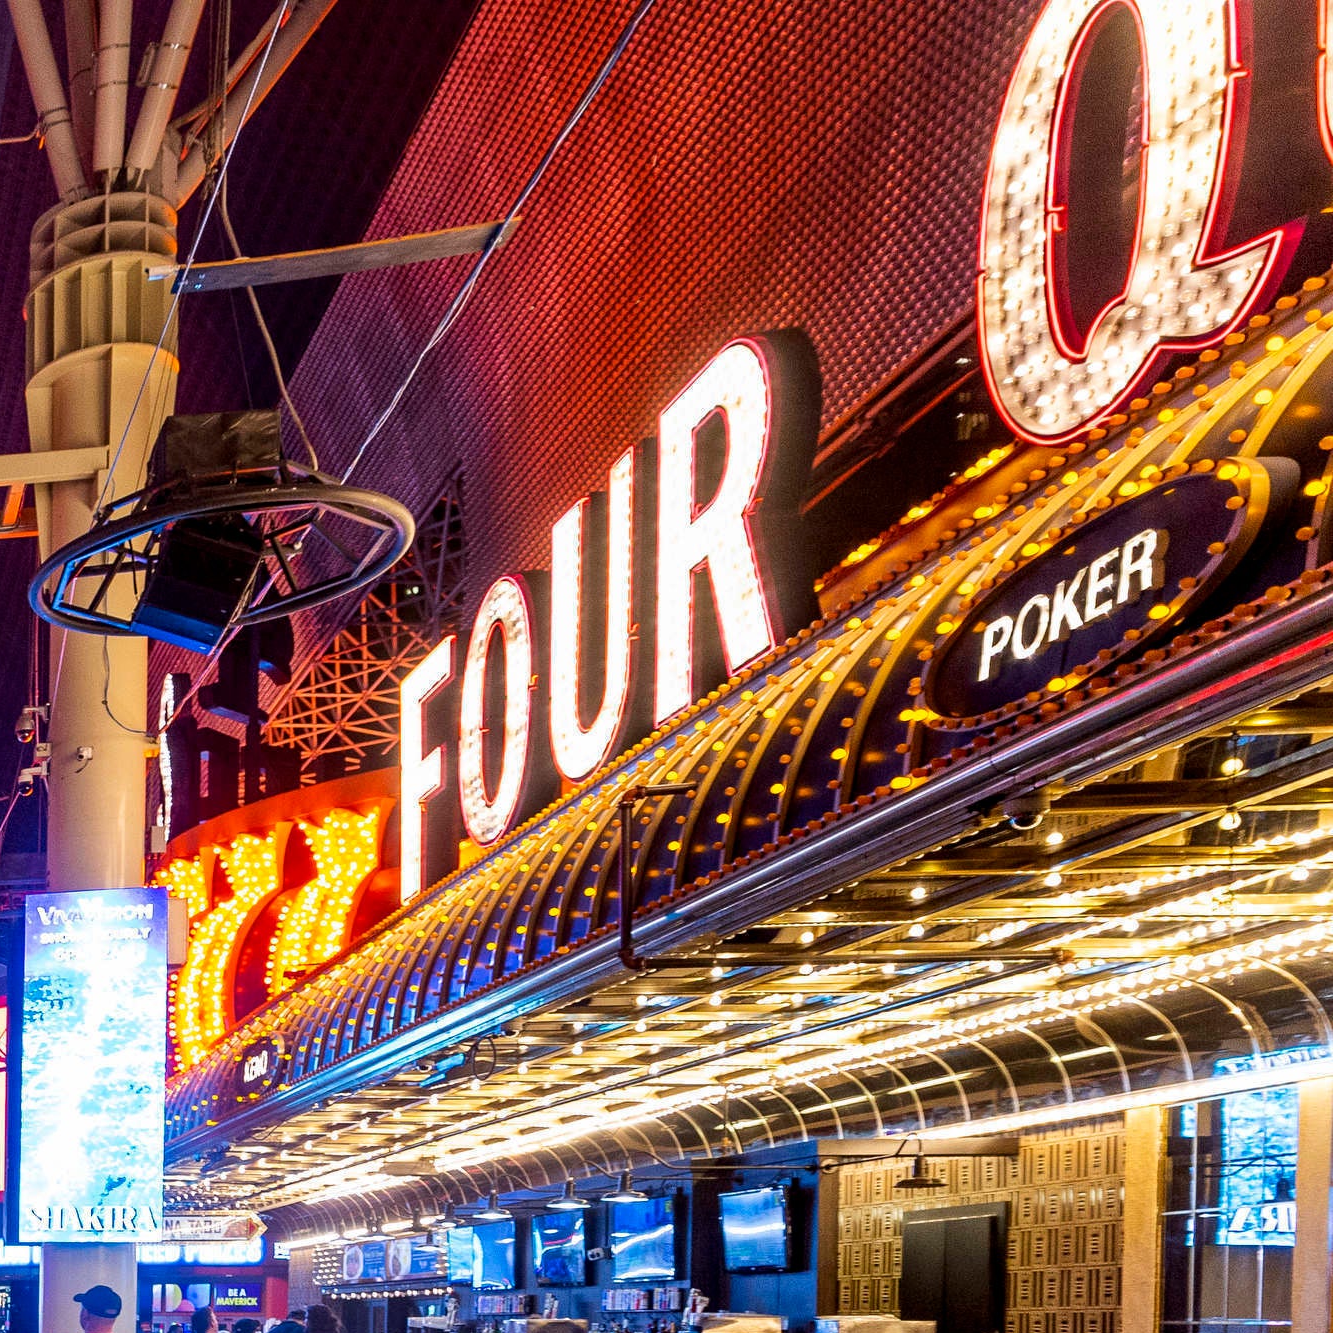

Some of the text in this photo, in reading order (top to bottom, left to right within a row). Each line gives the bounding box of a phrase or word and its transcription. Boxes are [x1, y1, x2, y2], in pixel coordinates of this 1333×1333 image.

[976, 0, 1333, 445] Q
[399, 336, 777, 905] FOUR
[977, 528, 1159, 682] POKER
[244, 1050, 268, 1084] KENO
[31, 1206, 158, 1232] SHAKIRA
[216, 1297, 258, 1306] MAVERICK
[228, 1288, 246, 1297] BE A
